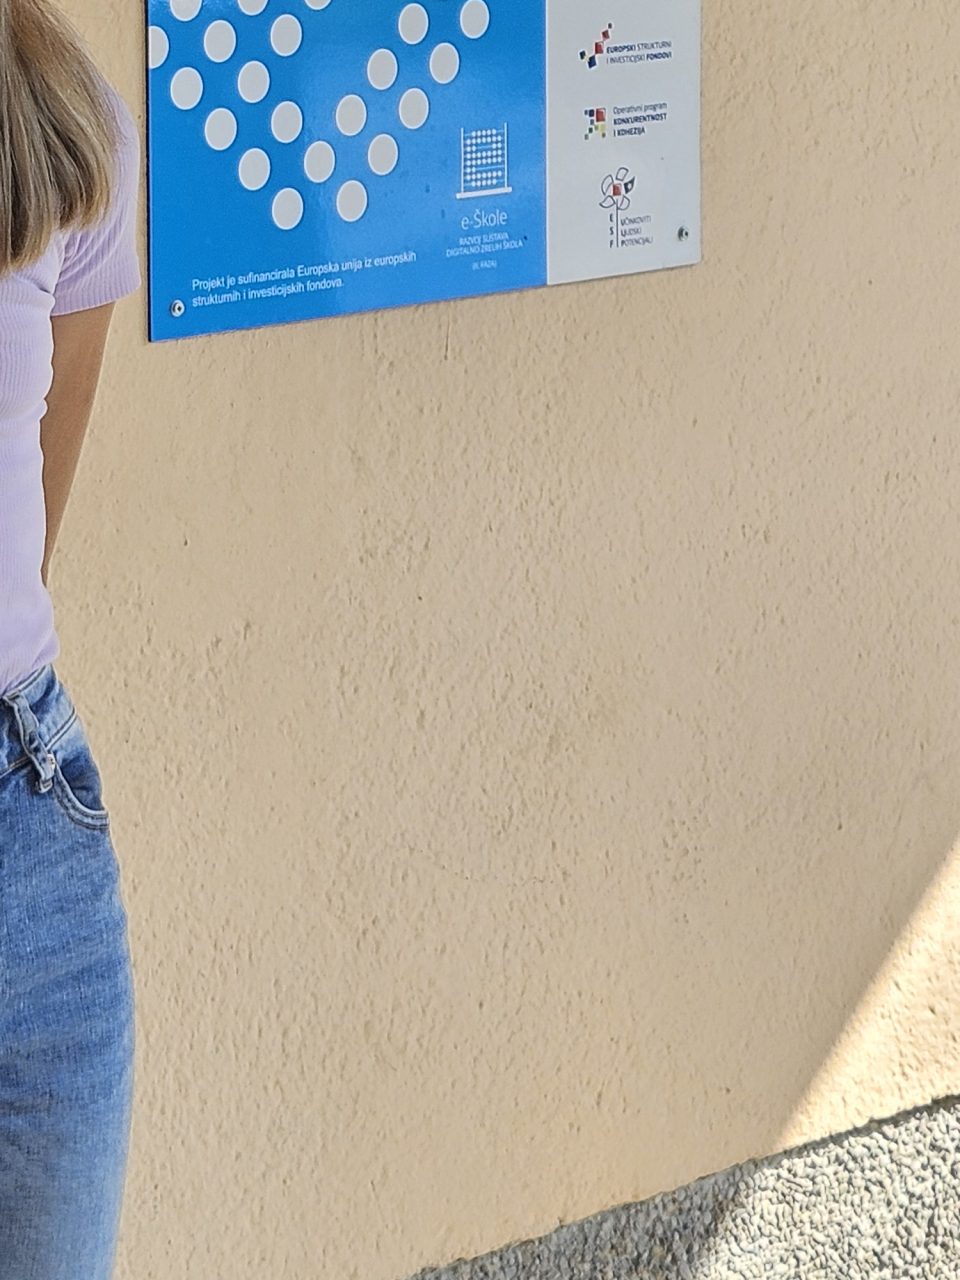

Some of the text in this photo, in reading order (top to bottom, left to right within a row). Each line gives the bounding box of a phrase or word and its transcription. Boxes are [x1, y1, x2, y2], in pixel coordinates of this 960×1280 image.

[606, 43, 636, 54] EUROPSKI
[646, 50, 672, 61] FONDOVI
[613, 112, 667, 126] KONKURENTNOST
[461, 208, 508, 231] e-Škole
[192, 250, 417, 292] Projekt je sufinancirala Europska unija iz europskih
[192, 289, 241, 308] strukturnih
[247, 280, 305, 298] investicijskih
